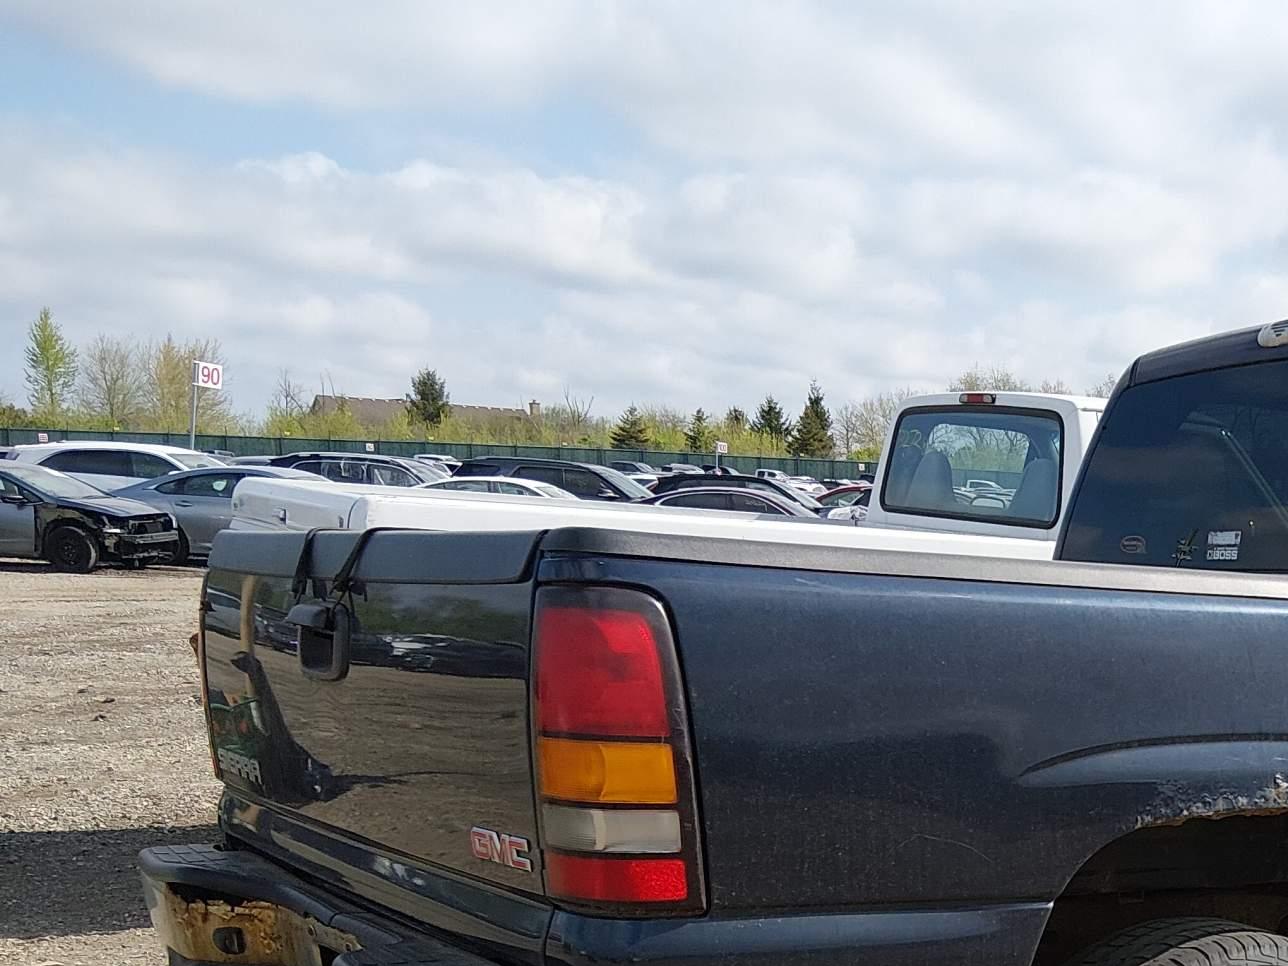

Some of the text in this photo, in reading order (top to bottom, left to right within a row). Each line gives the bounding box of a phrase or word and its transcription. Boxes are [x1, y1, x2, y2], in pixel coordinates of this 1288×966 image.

[201, 366, 220, 386] 90
[1213, 550, 1239, 560] BOSS
[217, 747, 262, 785] SIERRA
[471, 826, 532, 873] GMC
